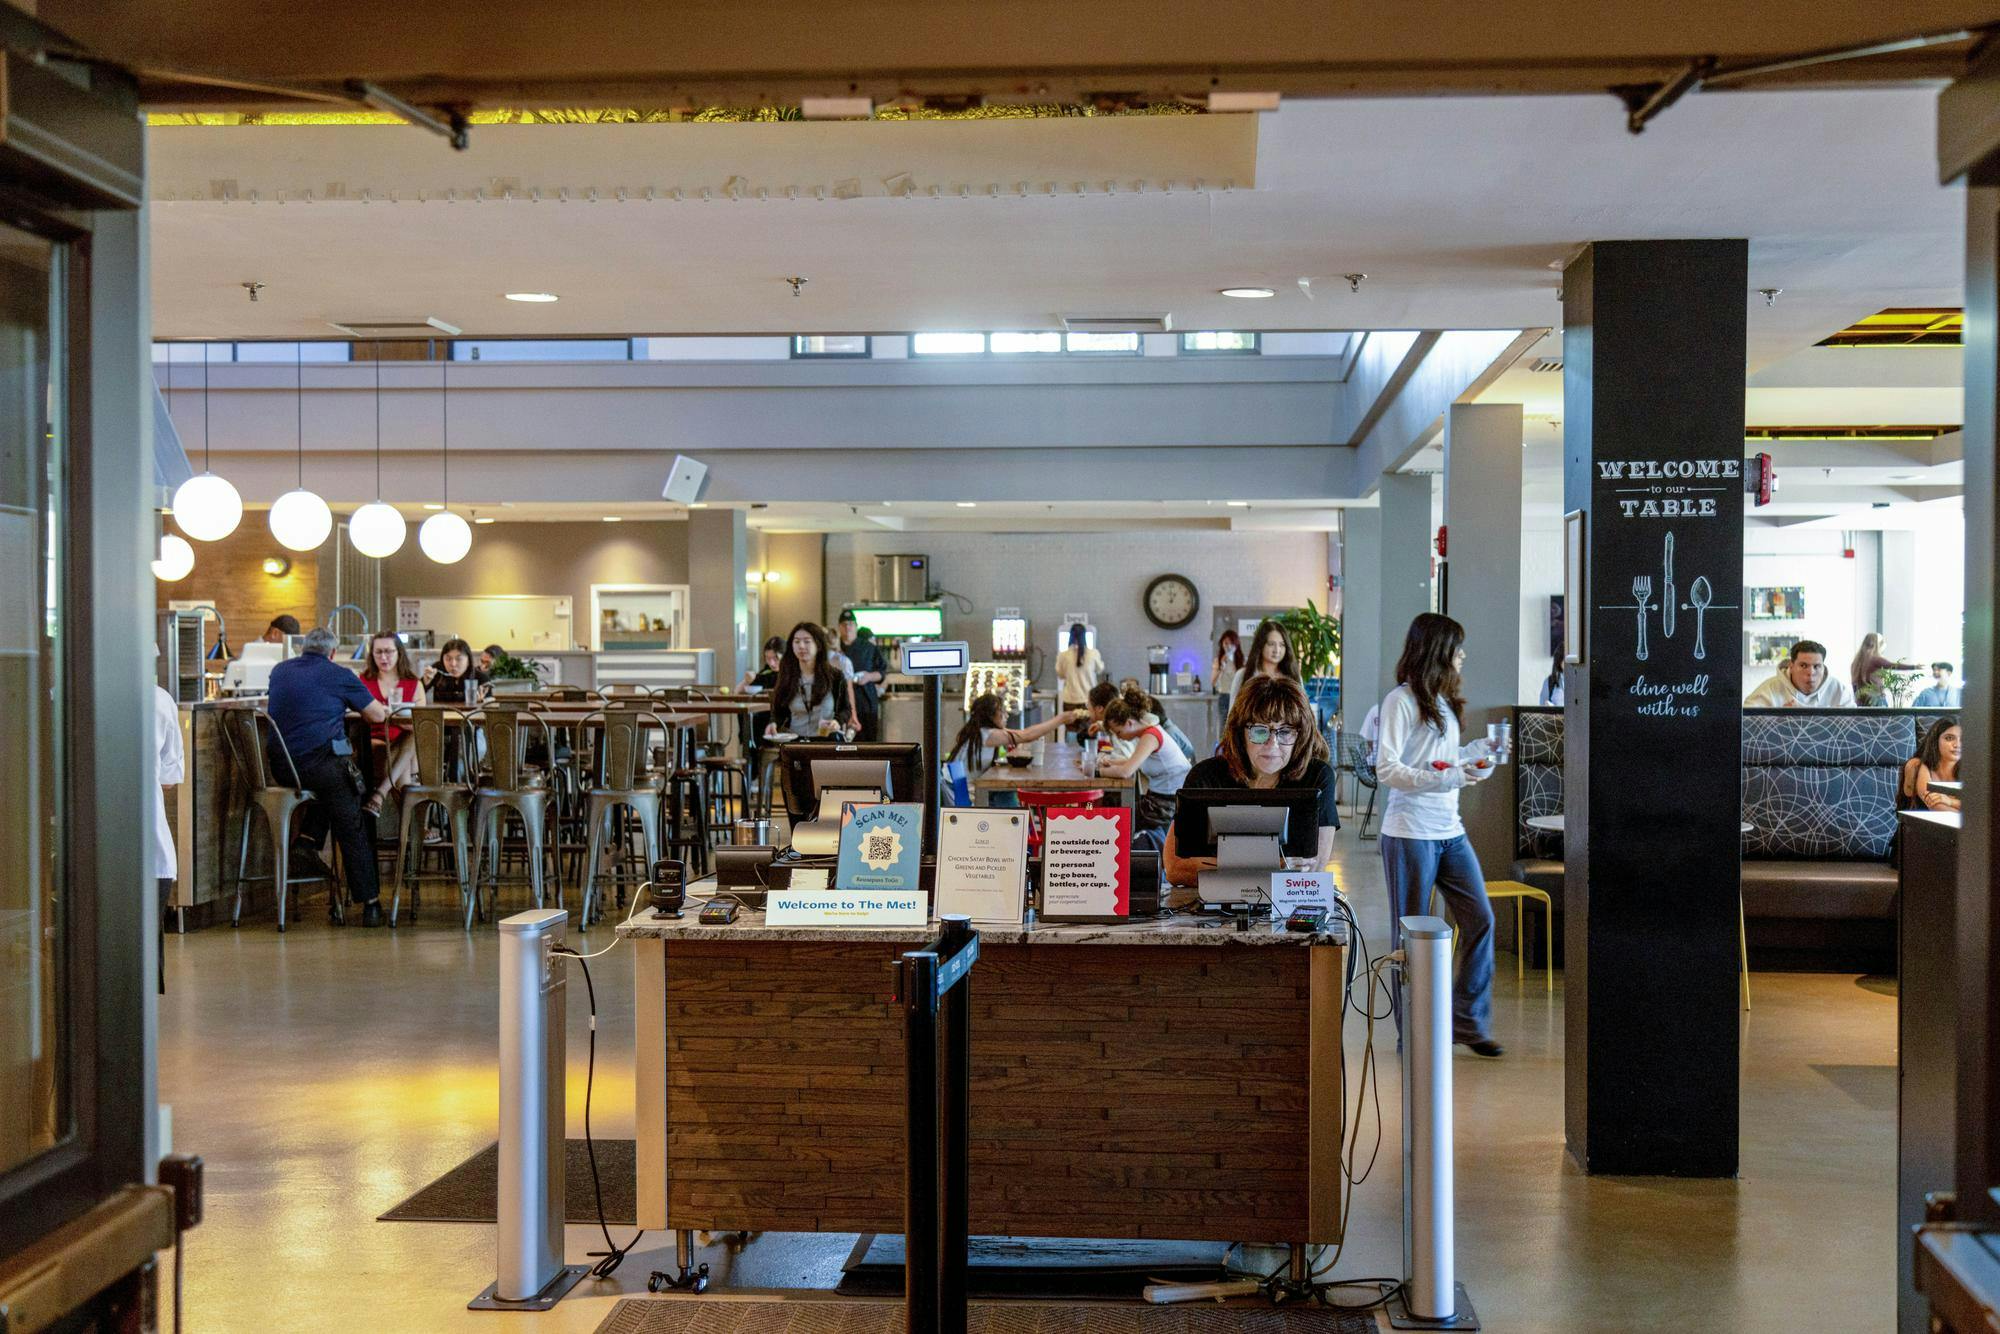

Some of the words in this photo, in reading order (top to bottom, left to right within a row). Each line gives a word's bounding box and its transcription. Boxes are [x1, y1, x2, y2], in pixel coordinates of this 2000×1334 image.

[1598, 460, 1739, 479] WELCOME
[1650, 485, 1662, 494] to
[1620, 499, 1716, 518] TABLE
[1630, 675, 1670, 695] dine
[1671, 674, 1709, 695] well
[1638, 694, 1678, 716] with
[1681, 705, 1700, 717] us
[856, 810, 885, 828] SCAN
[888, 811, 908, 827] ME!
[1286, 878, 1320, 888] Swipe,
[778, 901, 837, 909] Welcome
[841, 901, 854, 909] to
[858, 901, 883, 909] The
[886, 901, 916, 909] Met!
